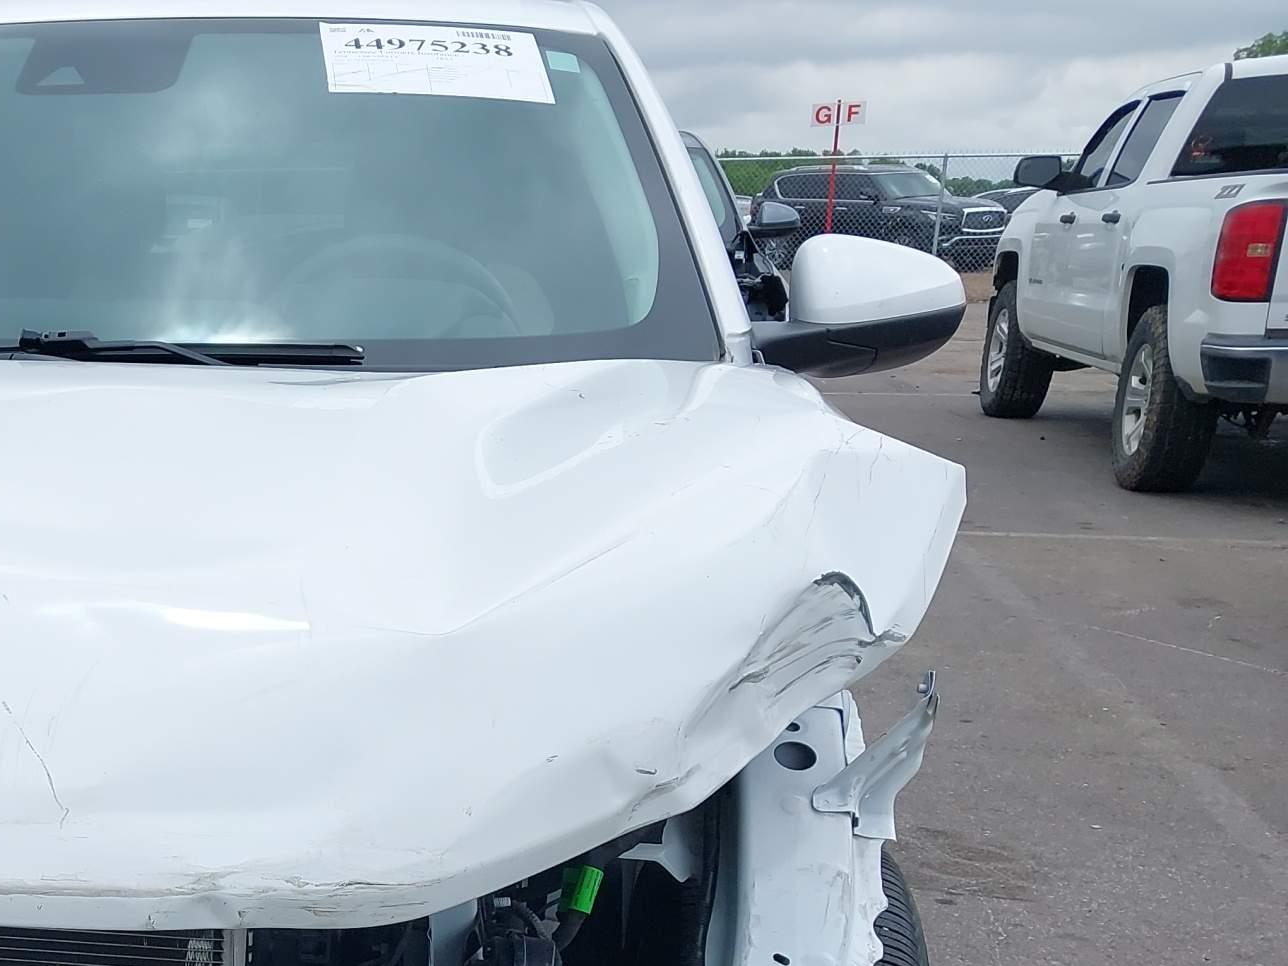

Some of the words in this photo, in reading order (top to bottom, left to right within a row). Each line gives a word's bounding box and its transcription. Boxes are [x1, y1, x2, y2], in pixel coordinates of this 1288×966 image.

[344, 37, 514, 57] 44975238
[815, 105, 832, 124] G
[847, 104, 861, 122] F
